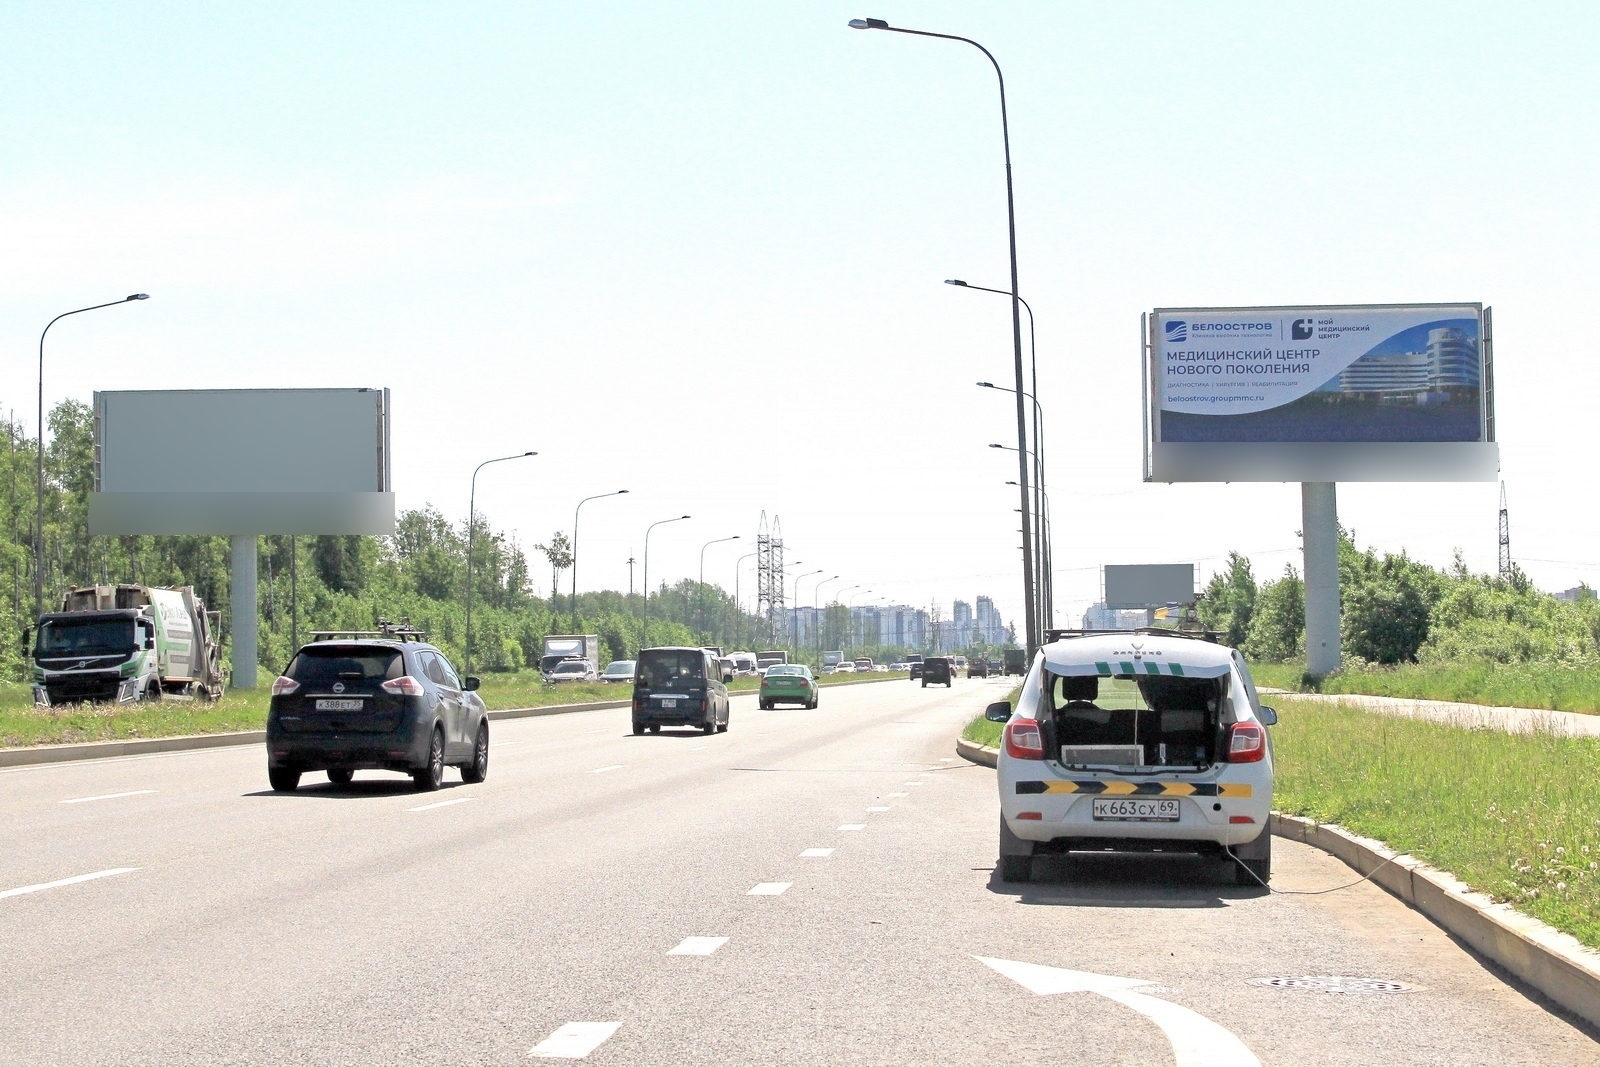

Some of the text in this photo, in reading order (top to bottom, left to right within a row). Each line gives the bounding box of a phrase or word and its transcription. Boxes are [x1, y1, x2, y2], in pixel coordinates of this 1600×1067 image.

[1192, 323, 1272, 331] БЕЛООСТРОВ
[1167, 348, 1320, 362] МЕДИЦИНСКИЙ ЦЕНТР
[1167, 364, 1310, 375] НОВОГО ПОКОЛЕНИЯ
[1167, 395, 1264, 404] beloostrov.groupmmc.ru
[1160, 801, 1174, 812] 69
